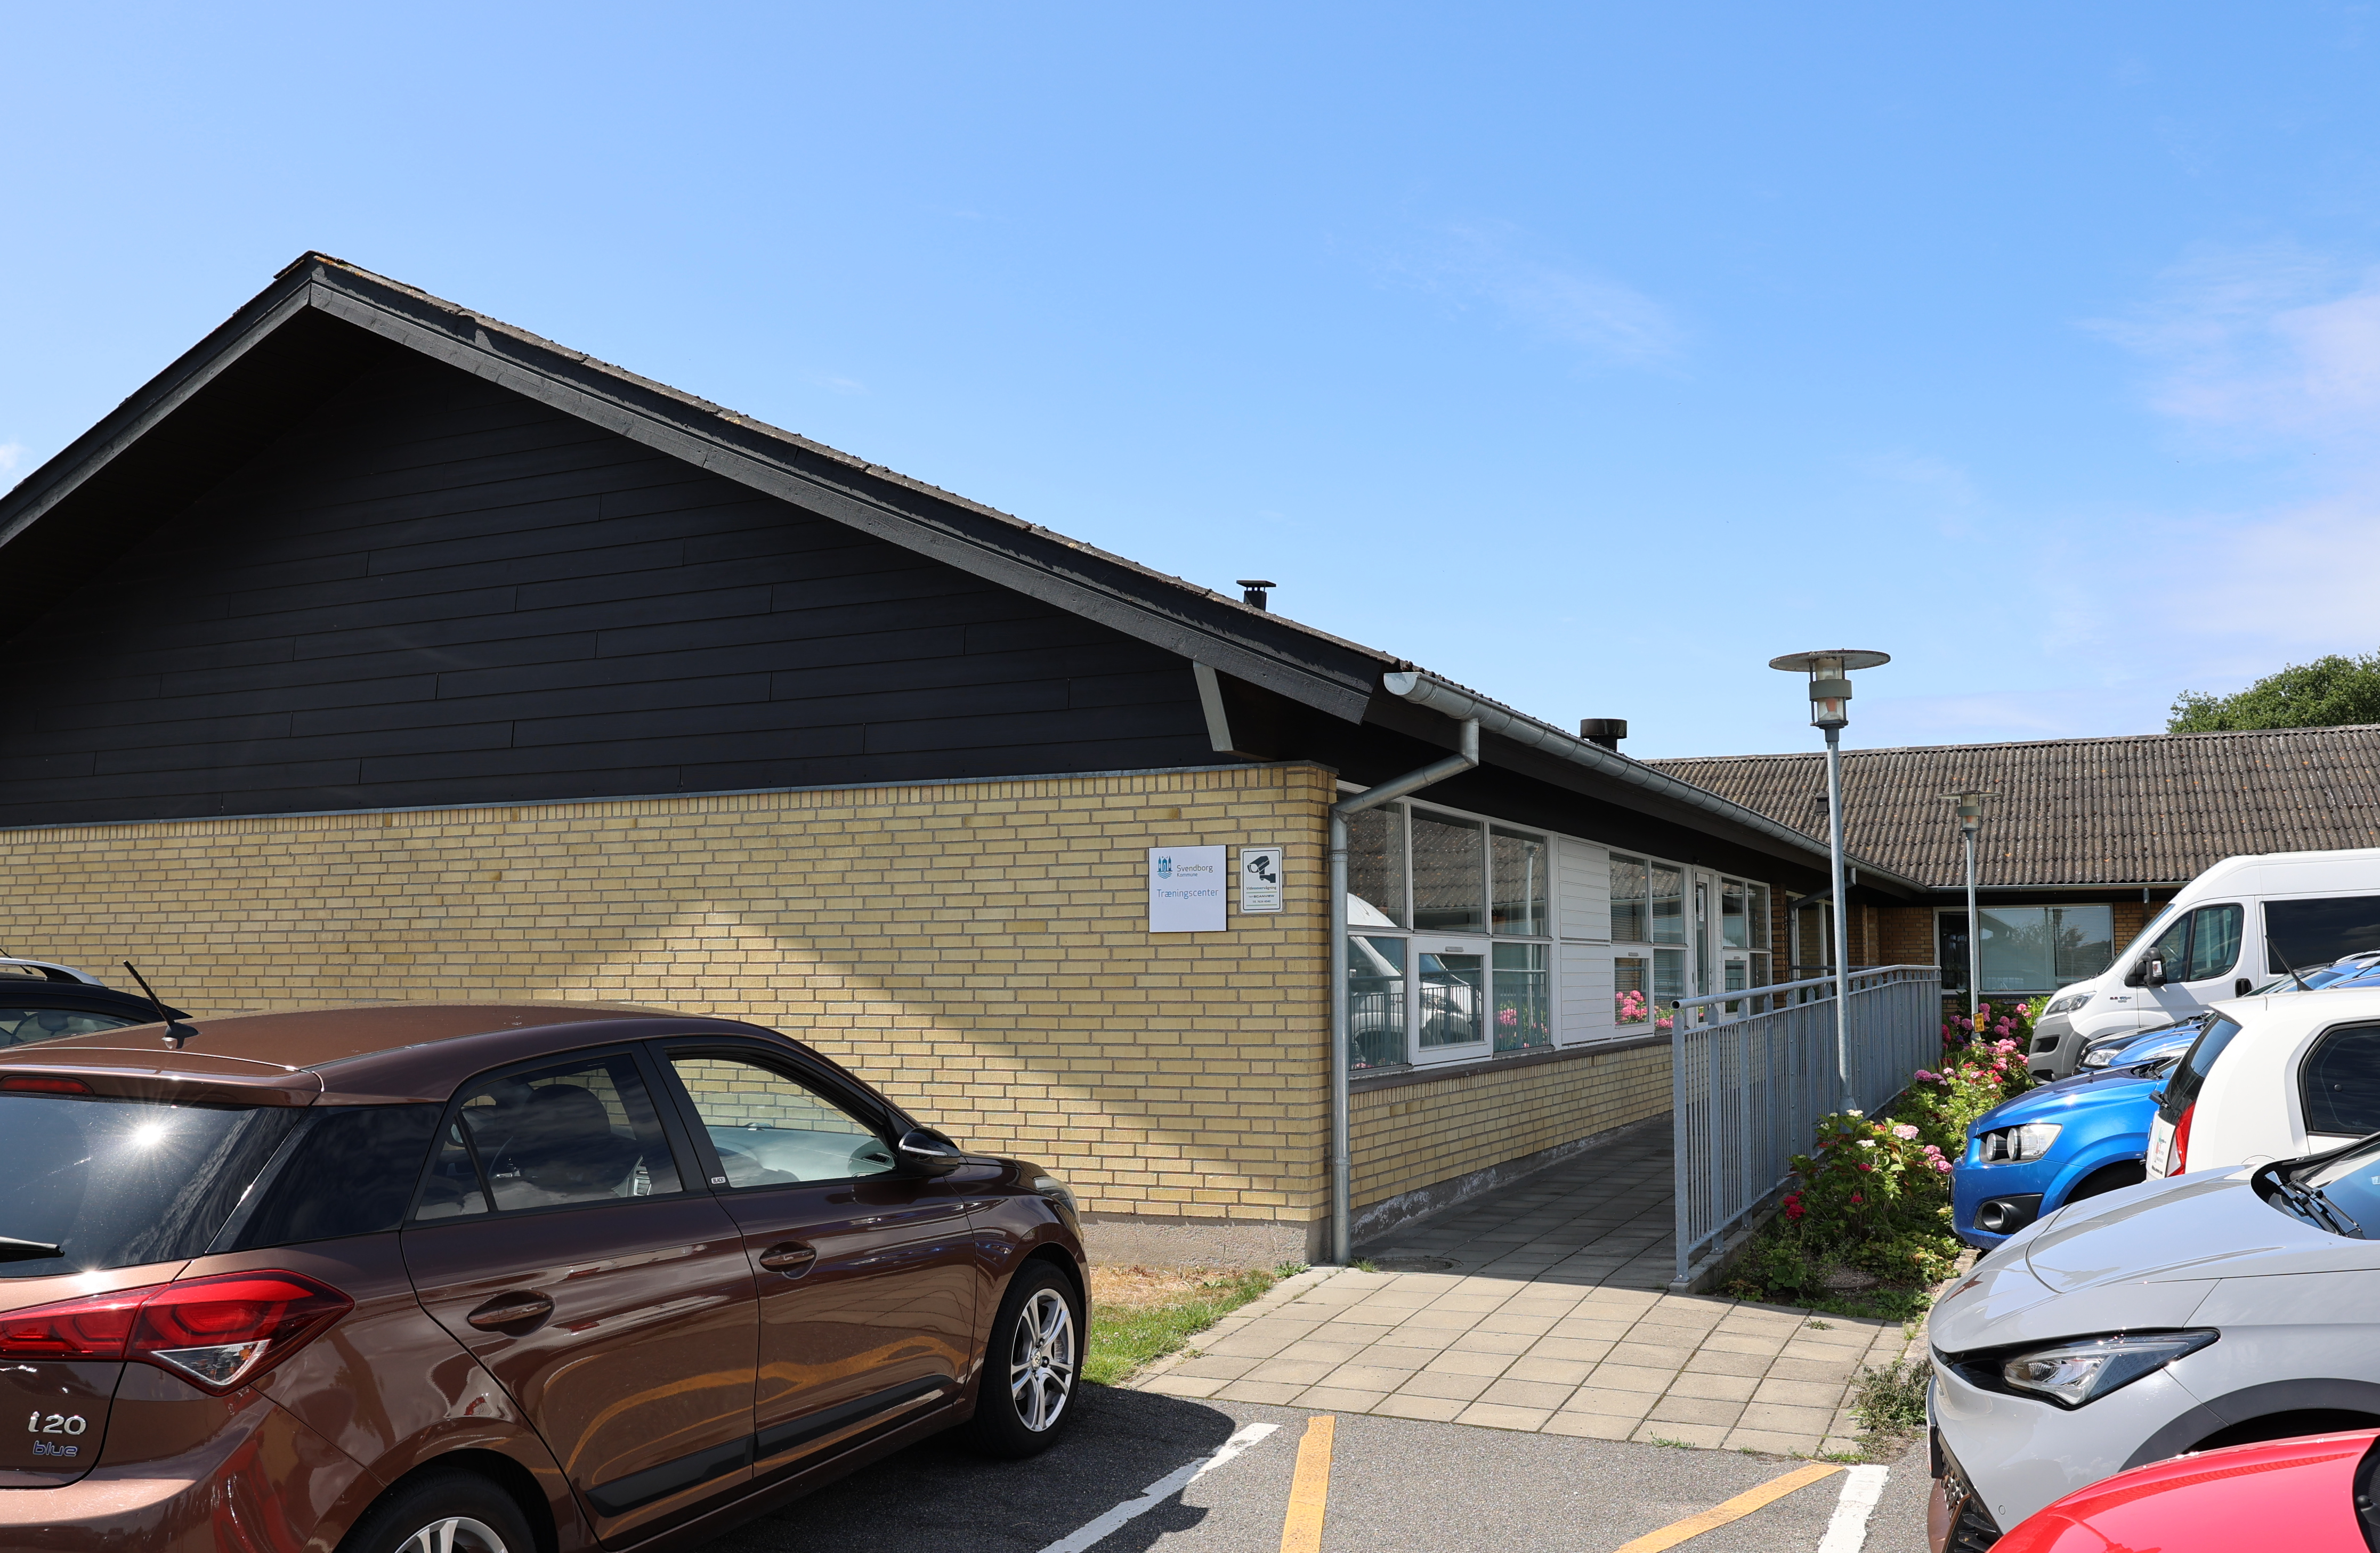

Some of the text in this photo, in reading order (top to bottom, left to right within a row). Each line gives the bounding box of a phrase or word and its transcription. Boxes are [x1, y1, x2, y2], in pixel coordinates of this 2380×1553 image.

[1177, 864, 1213, 873] Svendborg
[1156, 889, 1219, 899] Træningscenter
[28, 1411, 87, 1435] i20
[33, 1440, 78, 1457] blue
